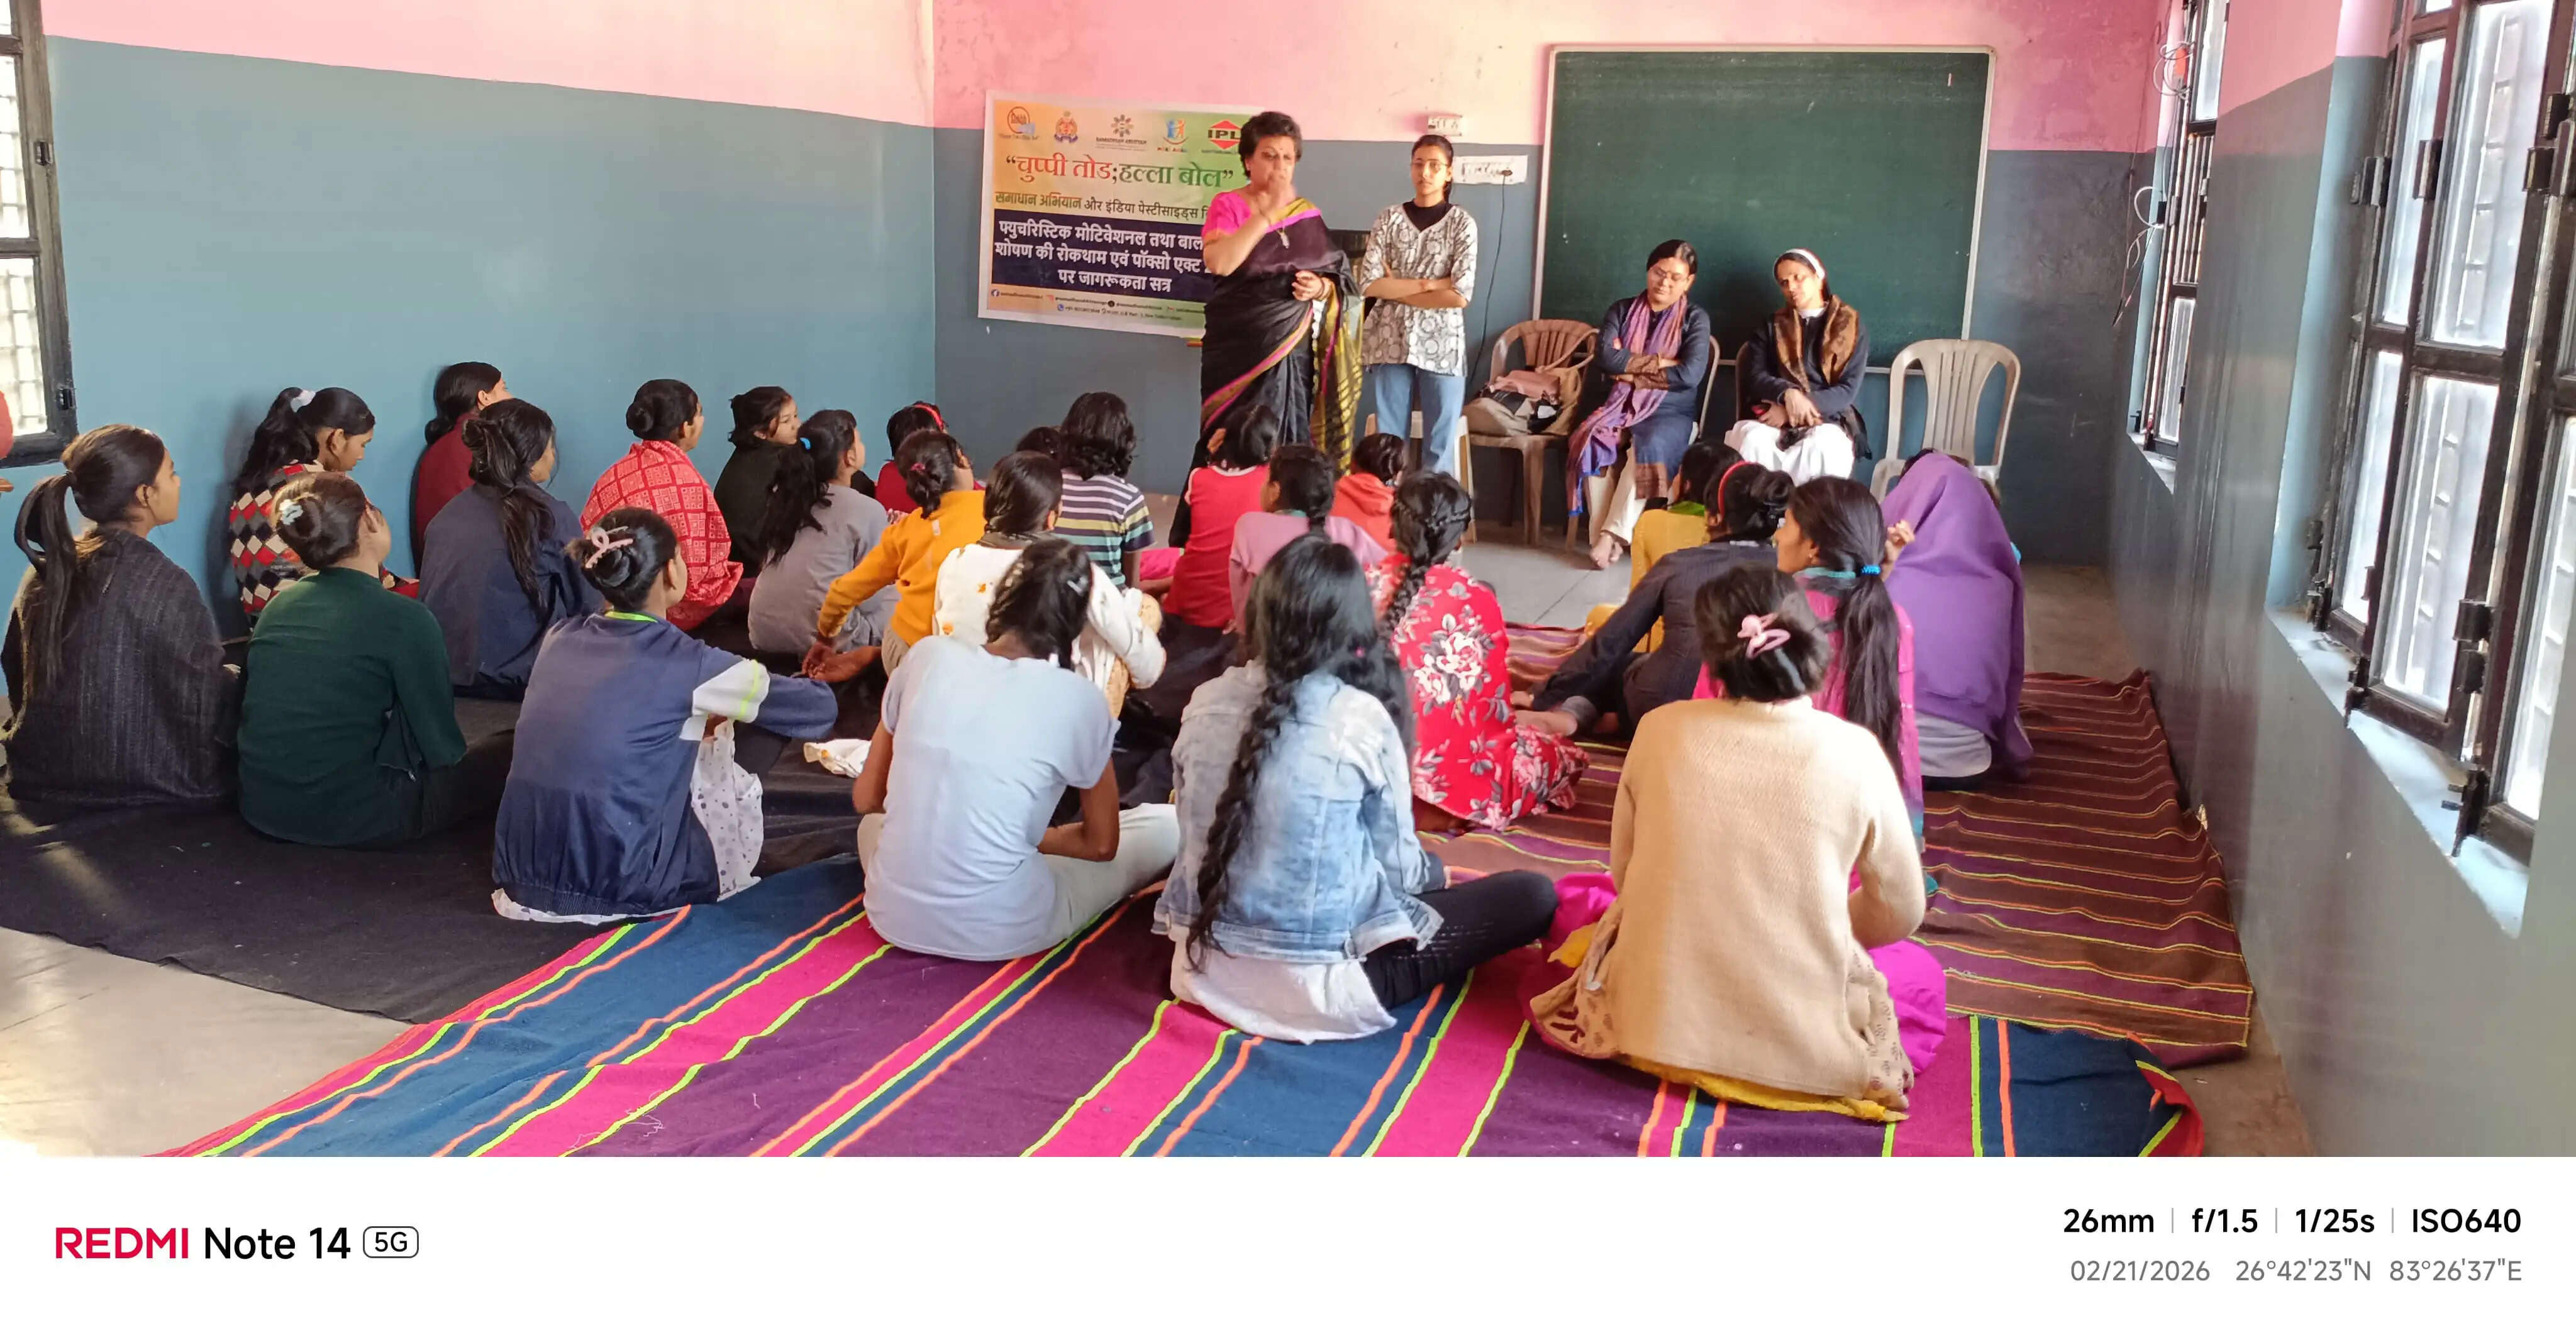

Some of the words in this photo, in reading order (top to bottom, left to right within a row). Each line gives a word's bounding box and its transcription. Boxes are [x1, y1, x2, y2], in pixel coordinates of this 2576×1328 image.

[1208, 130, 1240, 140] IPL
[995, 191, 1038, 206] समाधान
[1040, 192, 1082, 209] अभियान
[1106, 199, 1135, 214] इंडिया
[1075, 222, 1146, 246] मोटिवेशनल
[1149, 233, 1175, 248] तथा
[994, 238, 1033, 258] शोषण
[1036, 241, 1054, 260] की
[1057, 243, 1108, 265] रोकथाम
[1109, 250, 1130, 268] एवं
[1132, 250, 1171, 270] पॉक्सो
[1174, 257, 1202, 274] एक्ट
[1057, 269, 1076, 284] पर
[1078, 271, 1147, 291] जागरूकता
[1149, 277, 1172, 292] सत्र
